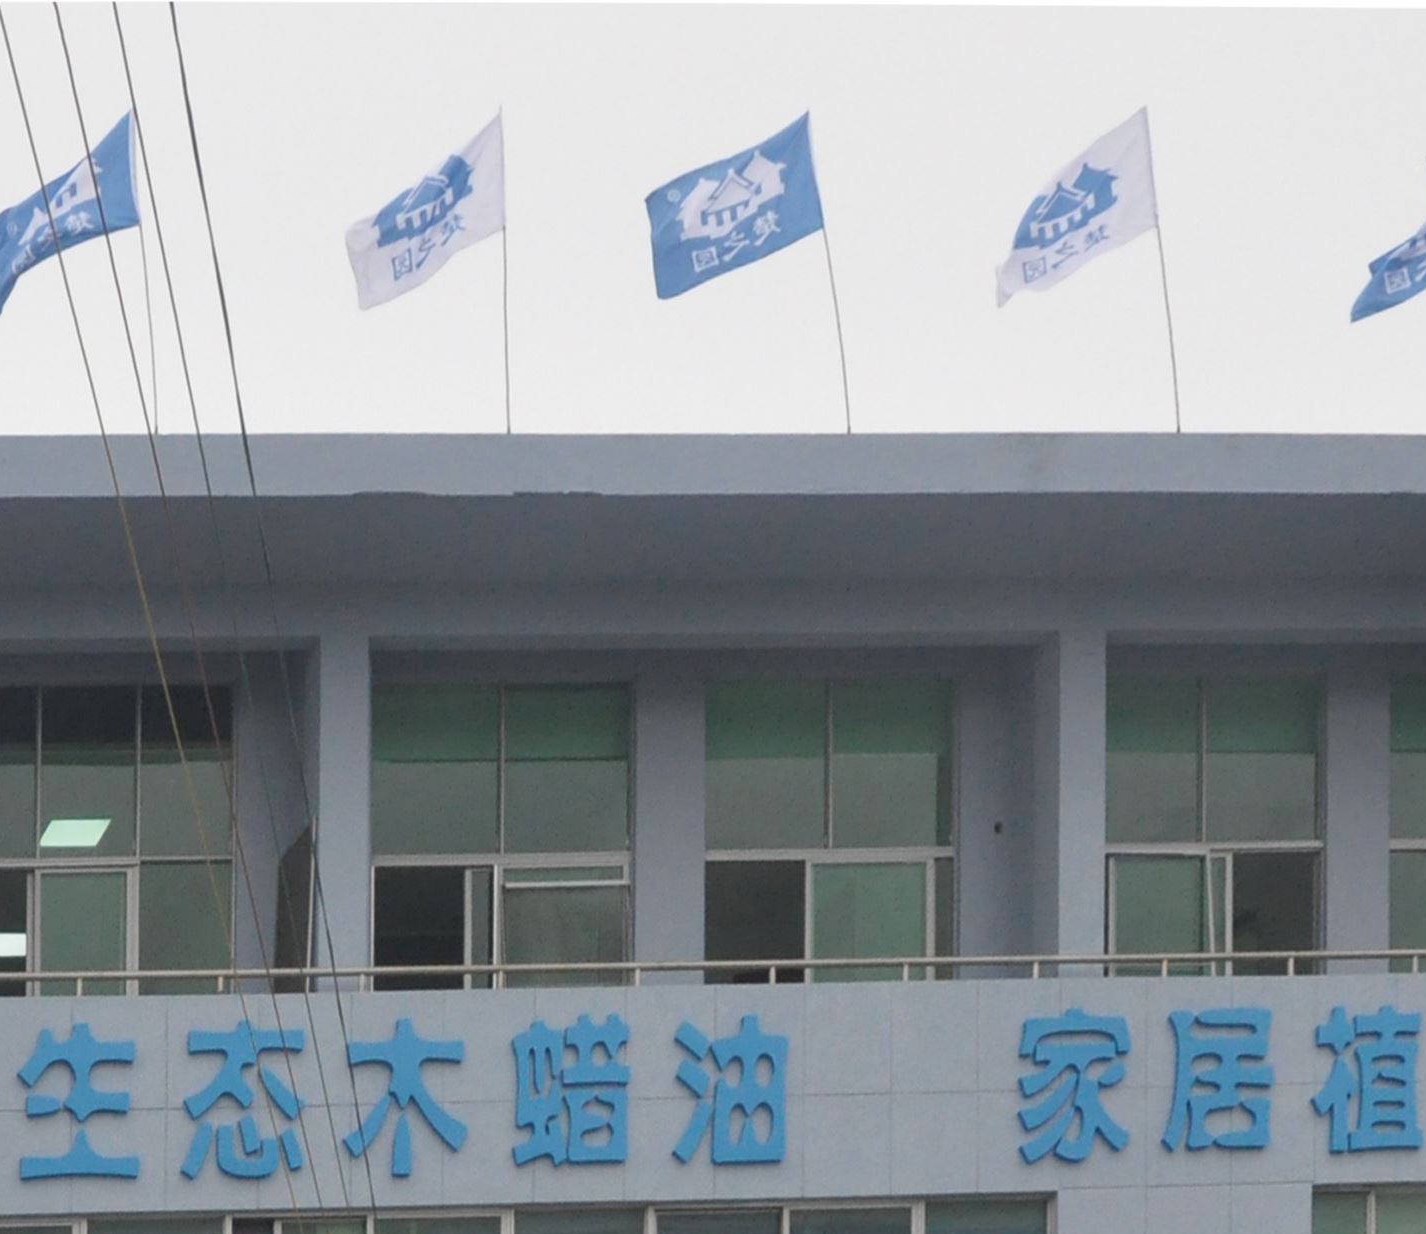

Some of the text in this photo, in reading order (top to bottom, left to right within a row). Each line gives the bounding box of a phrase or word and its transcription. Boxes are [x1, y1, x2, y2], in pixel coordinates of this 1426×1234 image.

[17, 1012, 790, 1182] 生态木蜡油
